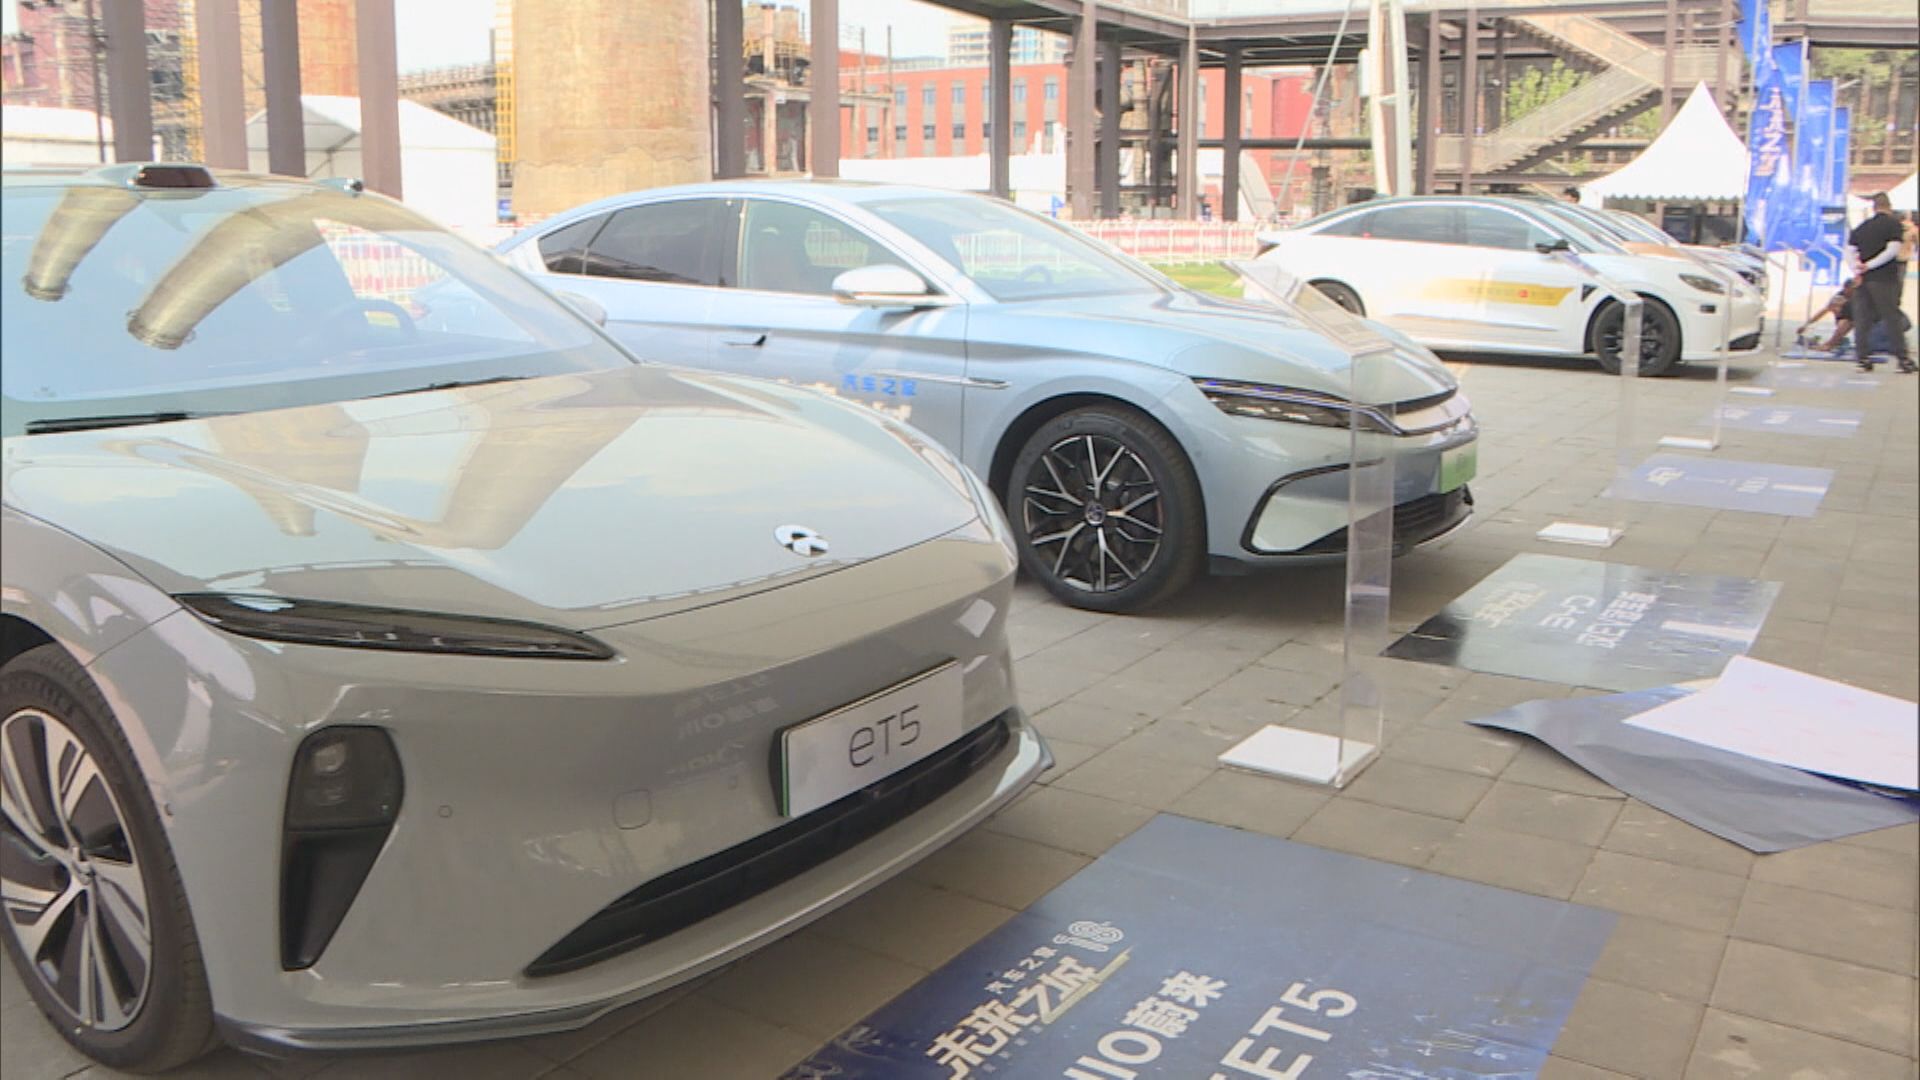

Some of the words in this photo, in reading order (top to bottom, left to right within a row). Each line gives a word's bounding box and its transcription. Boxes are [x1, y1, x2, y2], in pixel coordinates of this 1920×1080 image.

[1540, 594, 1597, 629] BYD
[926, 950, 1128, 1080] 未来之城
[985, 946, 1057, 994] 汽车之家
[1063, 970, 1228, 1080] IO蔚来
[1209, 981, 1358, 1080] ET5
